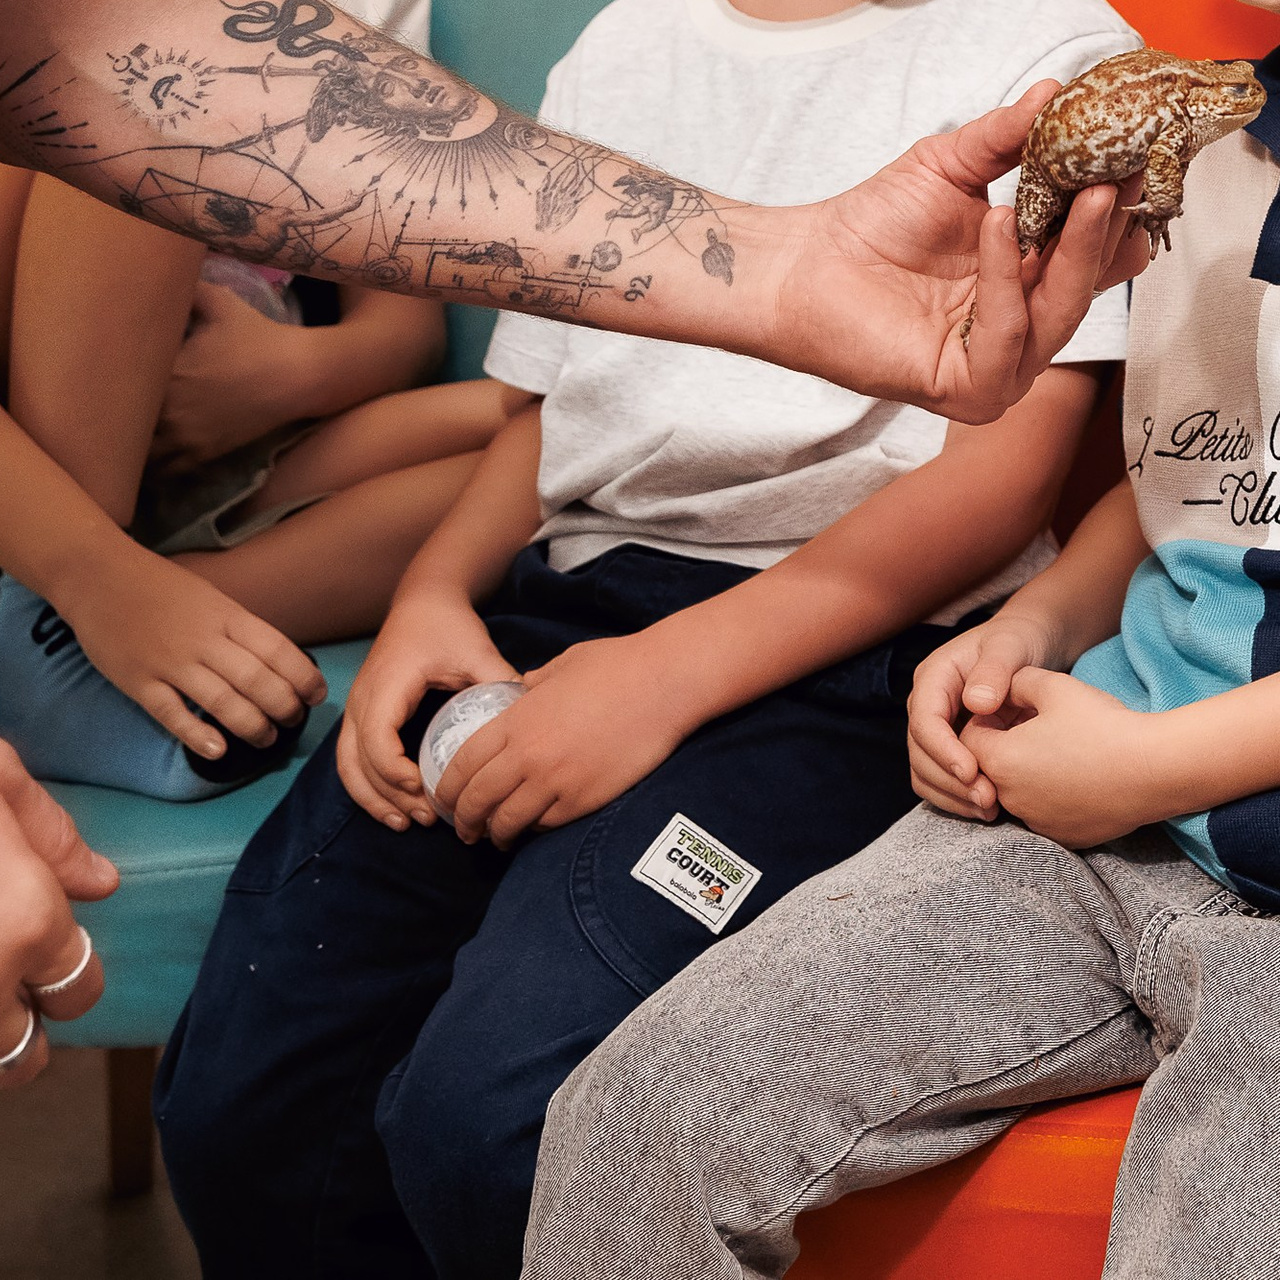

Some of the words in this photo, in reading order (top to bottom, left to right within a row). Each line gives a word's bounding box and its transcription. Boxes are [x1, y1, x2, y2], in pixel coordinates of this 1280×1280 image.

[1154, 410, 1253, 462] Petits
[666, 847, 730, 891] COURT
[677, 828, 745, 885] TENNIS
